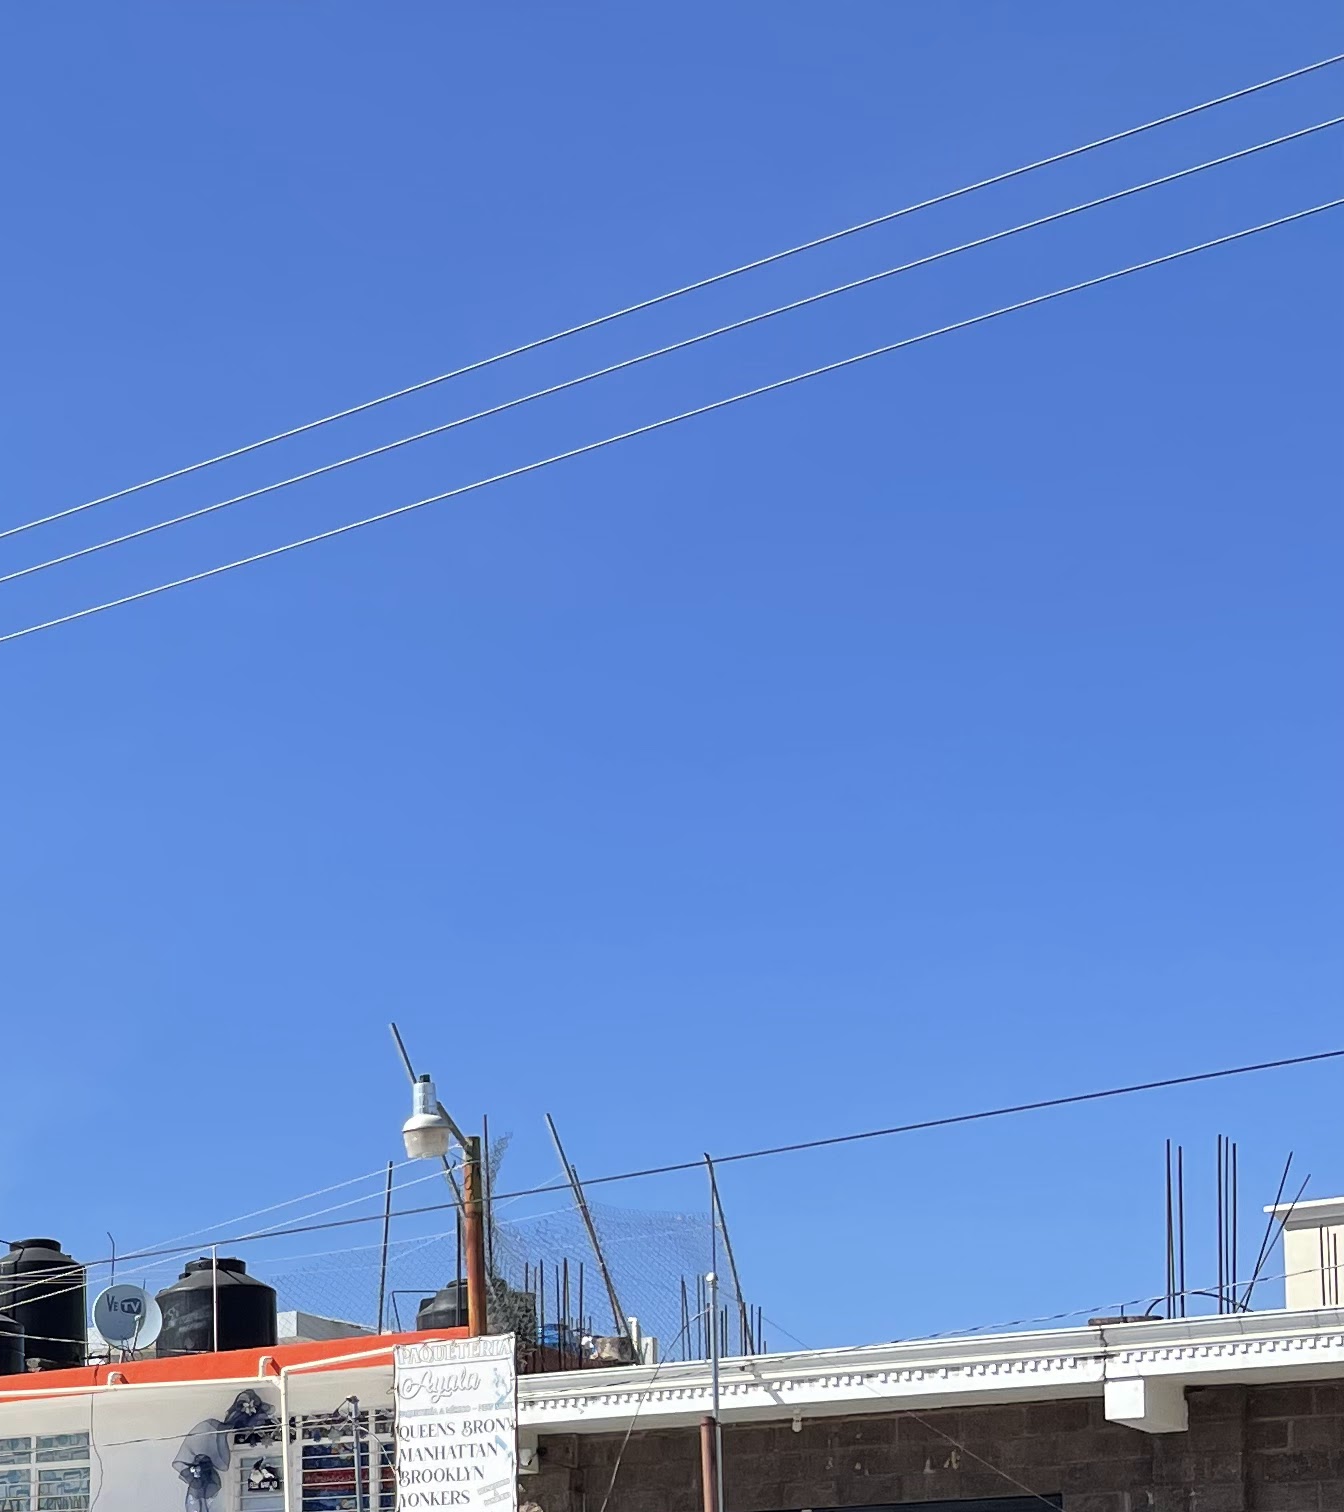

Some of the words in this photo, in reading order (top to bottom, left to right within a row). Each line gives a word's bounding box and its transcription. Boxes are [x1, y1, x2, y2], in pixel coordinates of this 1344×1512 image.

[399, 1366, 482, 1403] Ayala
[399, 1422, 456, 1442] QUEENS
[400, 1442, 498, 1462] MANHATTAN
[399, 1465, 485, 1488] BROOKLYN
[400, 1489, 471, 1508] YONKERS
